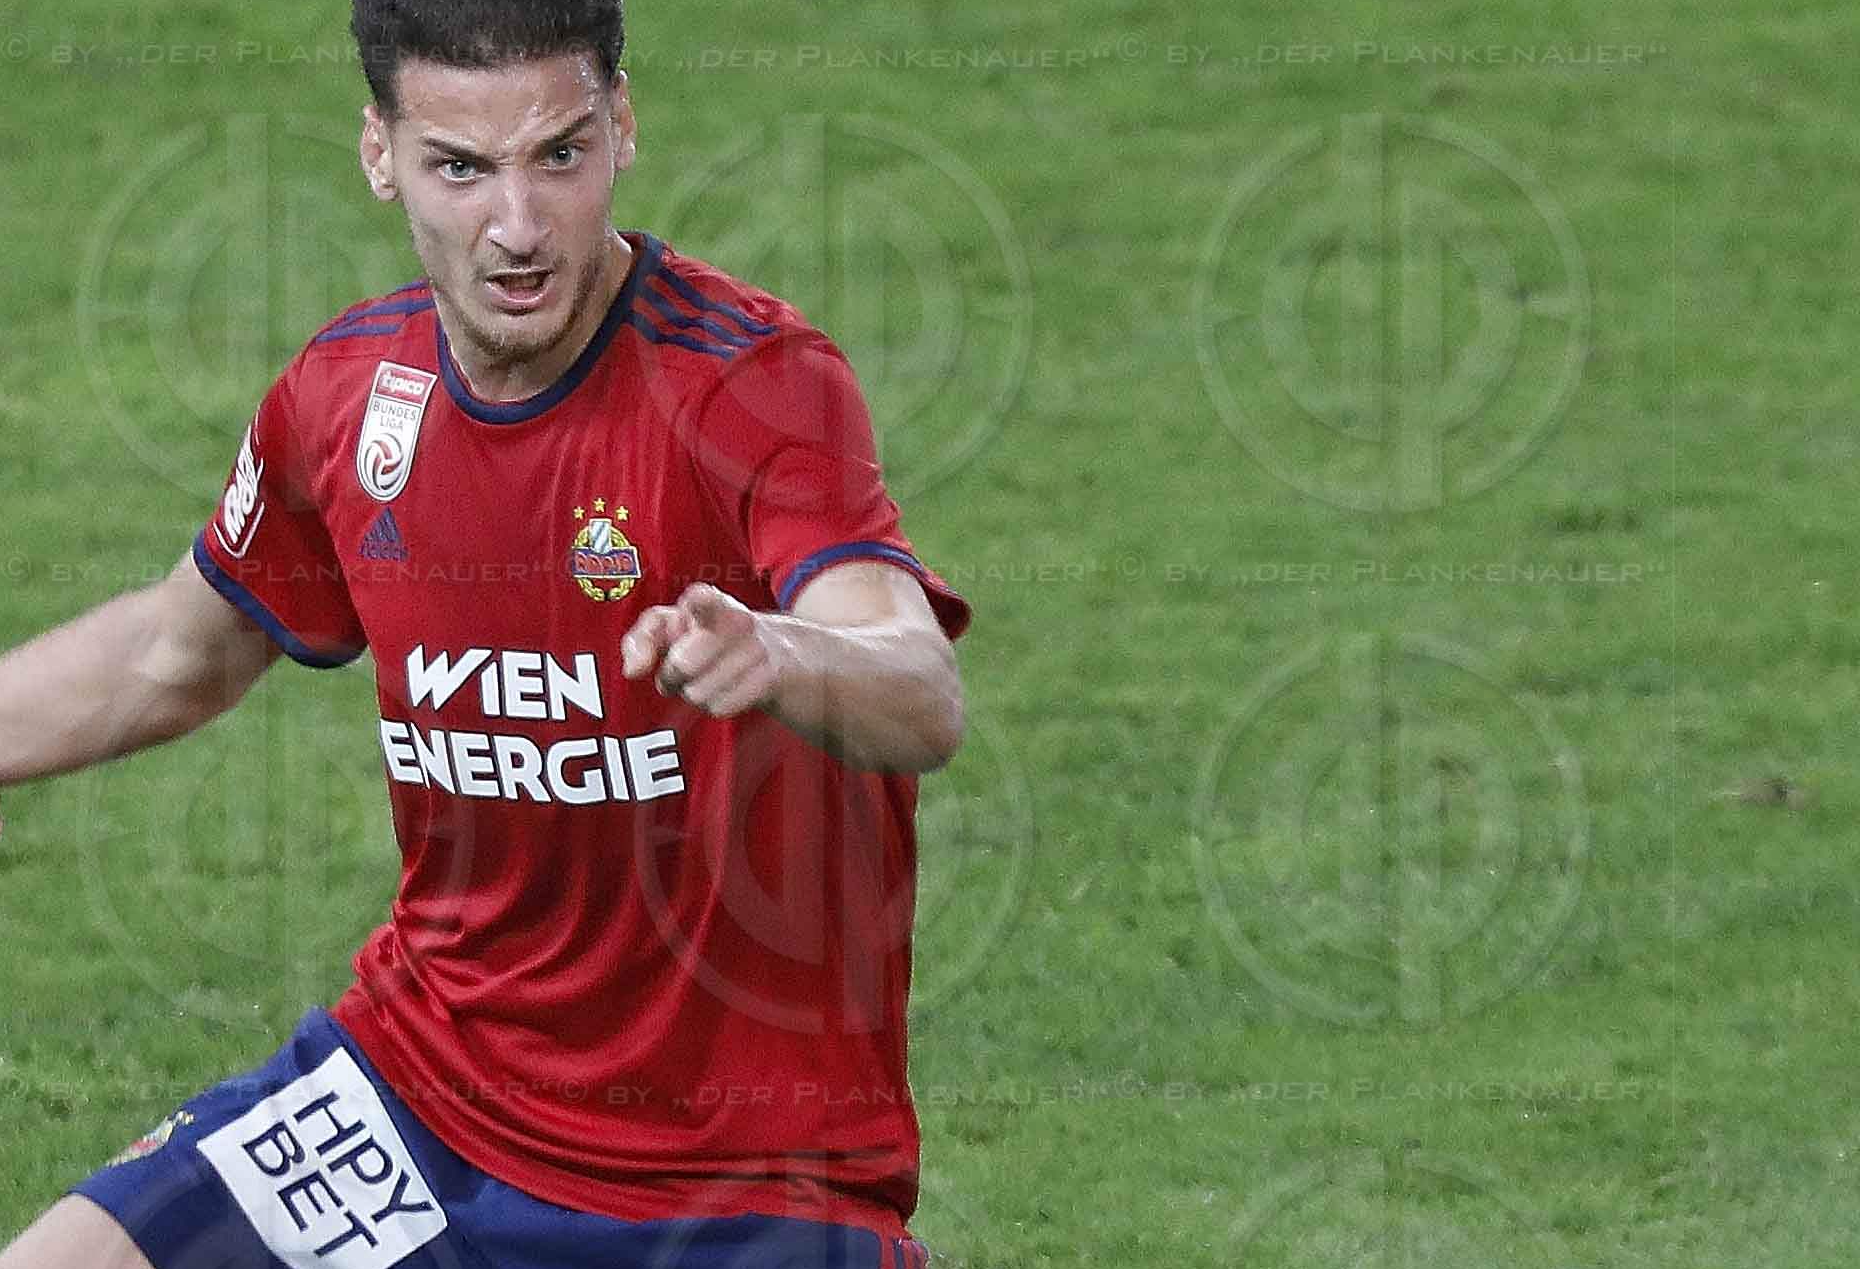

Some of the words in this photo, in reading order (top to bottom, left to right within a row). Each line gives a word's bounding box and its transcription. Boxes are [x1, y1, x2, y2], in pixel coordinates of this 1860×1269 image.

[404, 642, 604, 720] WIEN
[380, 718, 685, 806] ENERGIE
[241, 1120, 379, 1258] BET
[293, 1090, 436, 1225] HPY
